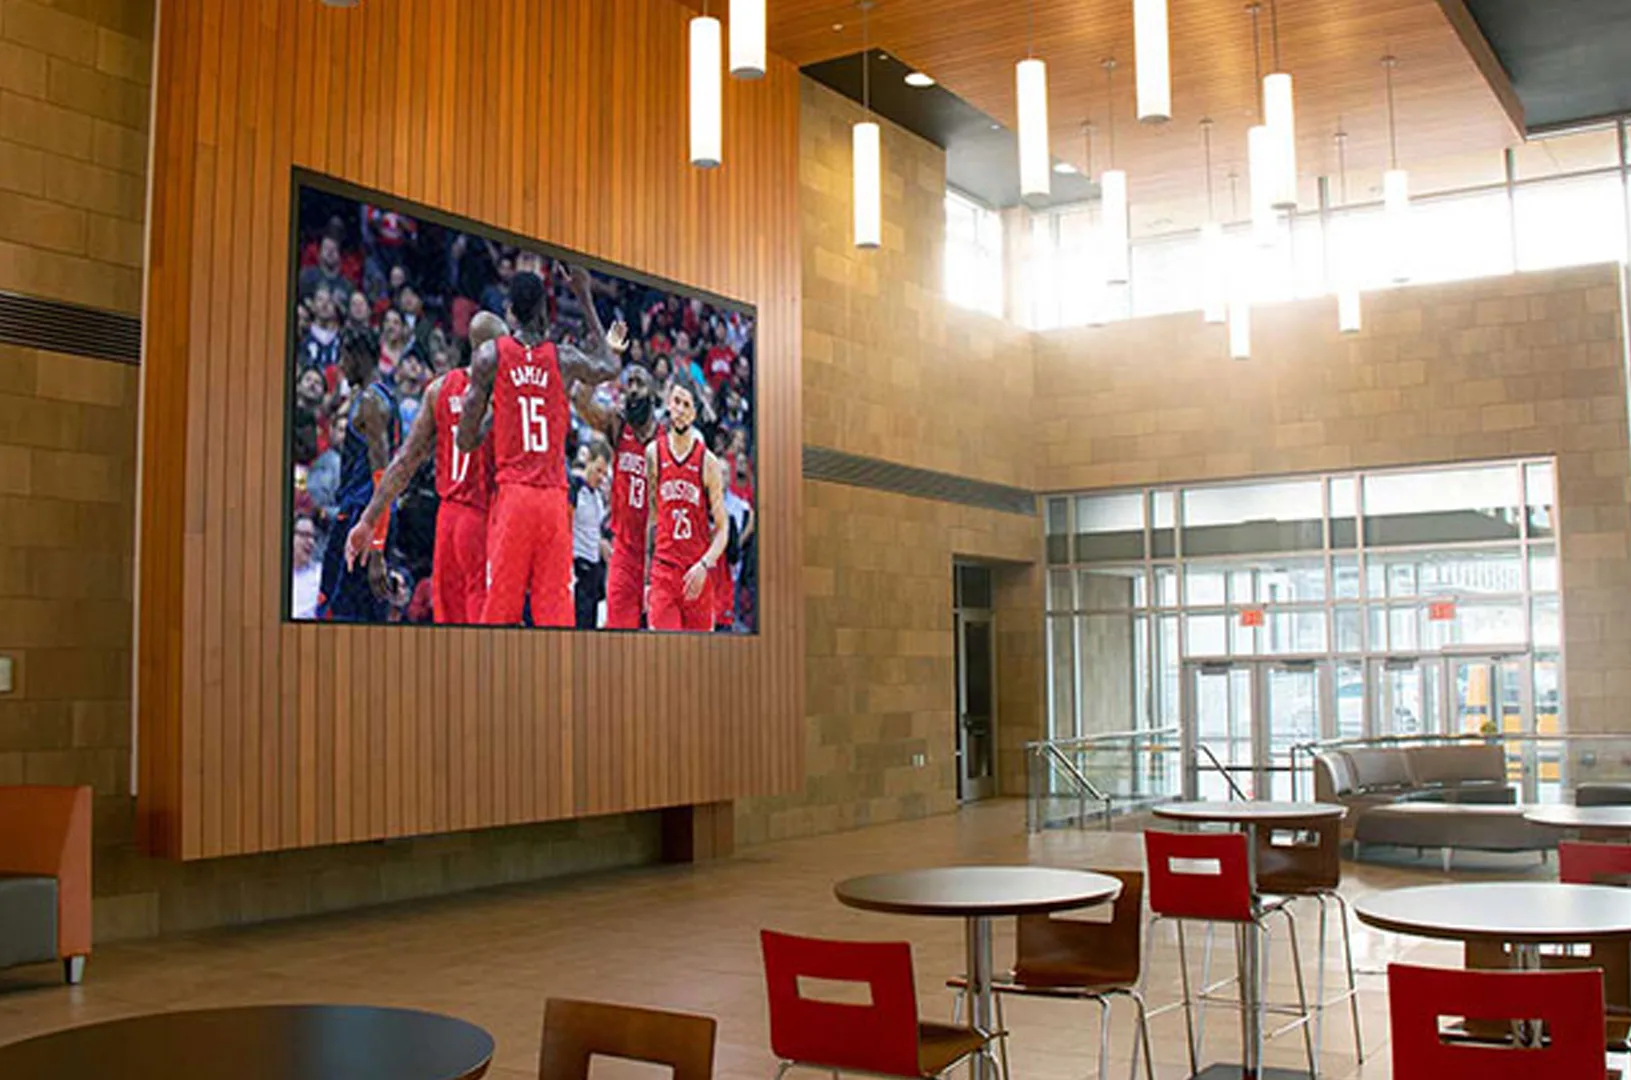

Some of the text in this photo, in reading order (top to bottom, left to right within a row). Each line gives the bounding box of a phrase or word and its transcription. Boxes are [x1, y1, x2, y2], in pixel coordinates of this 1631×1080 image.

[517, 395, 549, 453] 15
[628, 474, 646, 510] 13
[671, 508, 692, 540] 25
